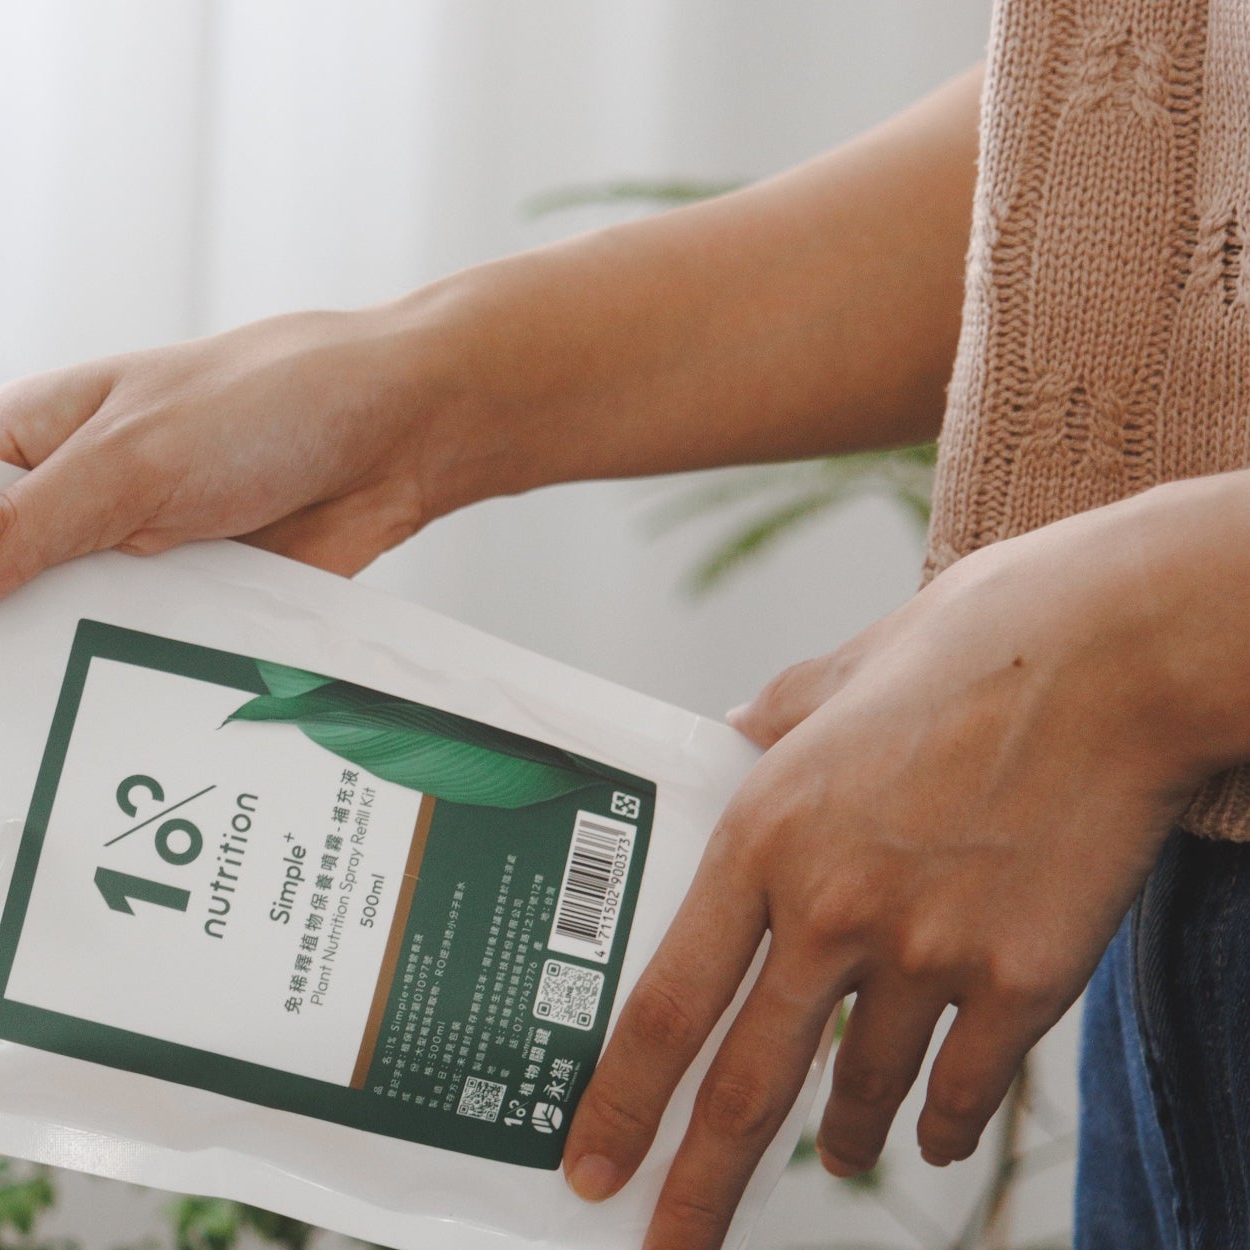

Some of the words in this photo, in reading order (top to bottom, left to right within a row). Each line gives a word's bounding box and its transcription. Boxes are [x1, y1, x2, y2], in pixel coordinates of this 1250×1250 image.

[359, 785, 376, 808] Kit
[350, 808, 370, 845] Refill
[206, 792, 258, 939] nutrition
[338, 847, 364, 893] Spray
[358, 871, 385, 929] 500ml
[597, 889, 620, 940] 711502
[320, 893, 350, 962] Nutrition
[593, 948, 606, 958] 4
[309, 963, 332, 1007] Plant
[563, 984, 575, 1004] LINE
